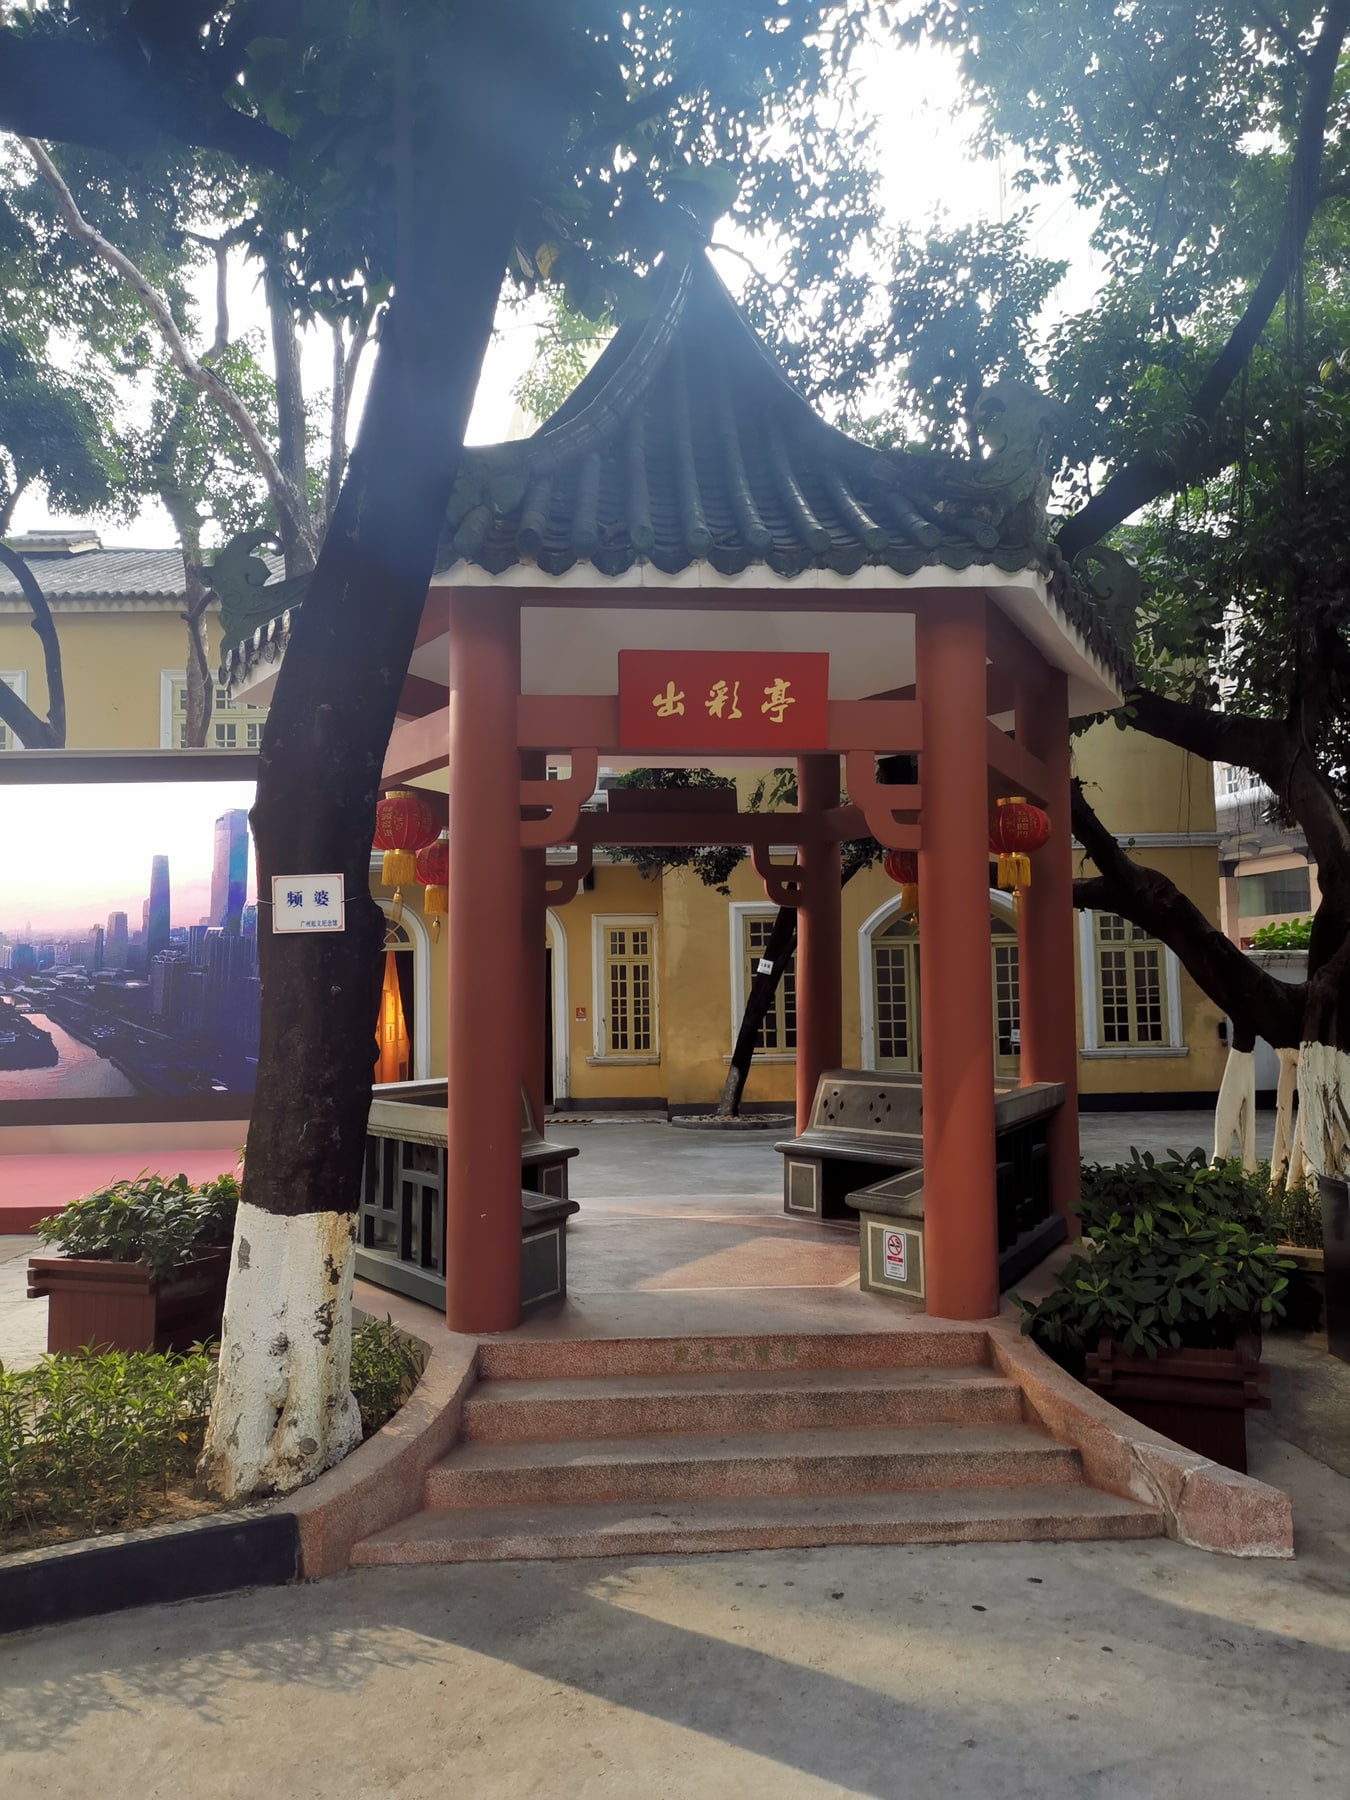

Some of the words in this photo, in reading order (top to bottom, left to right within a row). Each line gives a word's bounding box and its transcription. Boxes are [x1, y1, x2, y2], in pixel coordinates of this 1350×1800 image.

[651, 677, 796, 723] 出彩亭
[287, 890, 329, 908] 频婆
